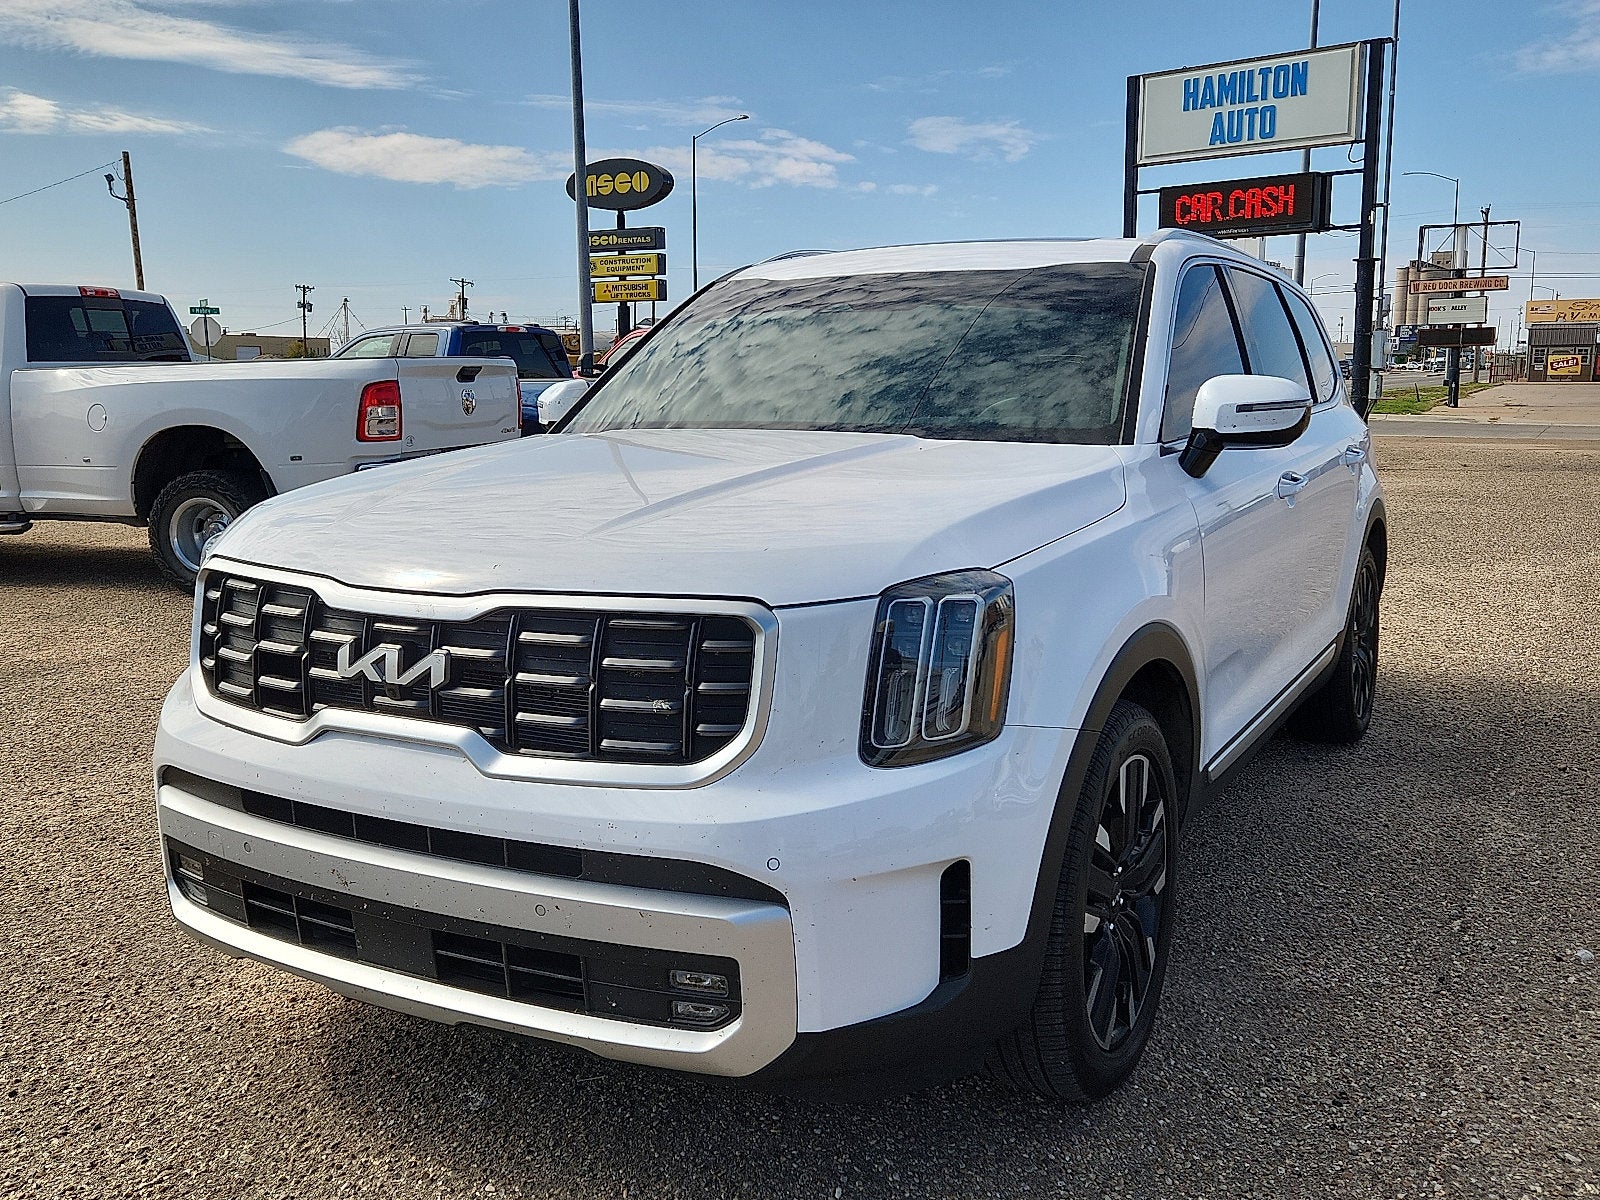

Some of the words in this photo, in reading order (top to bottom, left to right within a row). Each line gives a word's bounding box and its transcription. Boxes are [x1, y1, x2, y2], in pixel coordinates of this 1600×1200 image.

[1182, 61, 1309, 112] HAMILTON
[1209, 104, 1277, 146] AUTO
[1175, 191, 1223, 225] CAR
[1228, 184, 1295, 220] CASH
[588, 234, 617, 247] SCO
[617, 236, 651, 245] RENTALS
[599, 257, 652, 266] CONSTRUCTION
[606, 265, 645, 273] EQUIPMENT
[611, 283, 649, 292] MITSUBISHI
[1438, 281, 1458, 290] DOOR
[1459, 279, 1492, 289] BREWING
[625, 291, 652, 299] TRUCKS
[1552, 359, 1577, 369] SALE!
